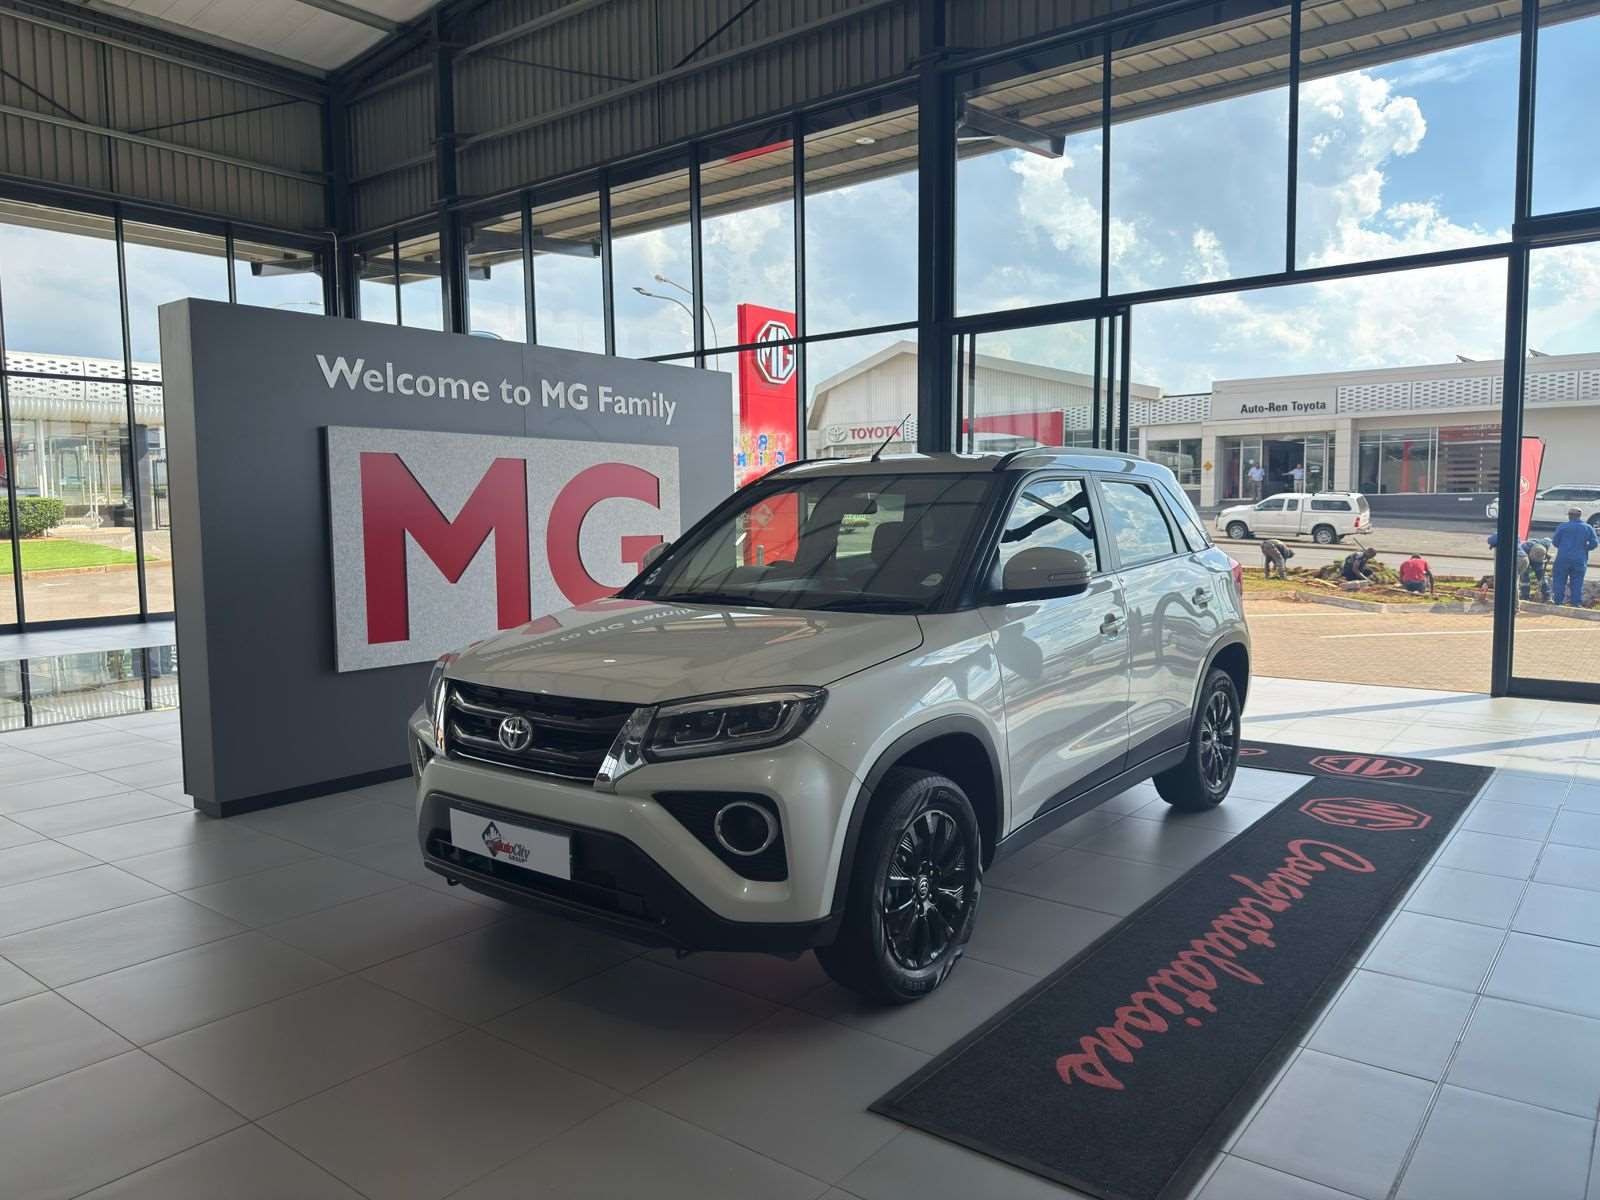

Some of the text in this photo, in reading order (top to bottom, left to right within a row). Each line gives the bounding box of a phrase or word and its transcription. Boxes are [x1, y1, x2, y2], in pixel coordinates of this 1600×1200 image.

[759, 324, 795, 380] MG
[316, 353, 677, 425] Welcome to MG Family
[1240, 401, 1326, 414] Auto-Ren Toyota
[849, 425, 901, 440] TOYOTA
[359, 451, 664, 645] MG
[1056, 839, 1376, 1090] Congratulations
